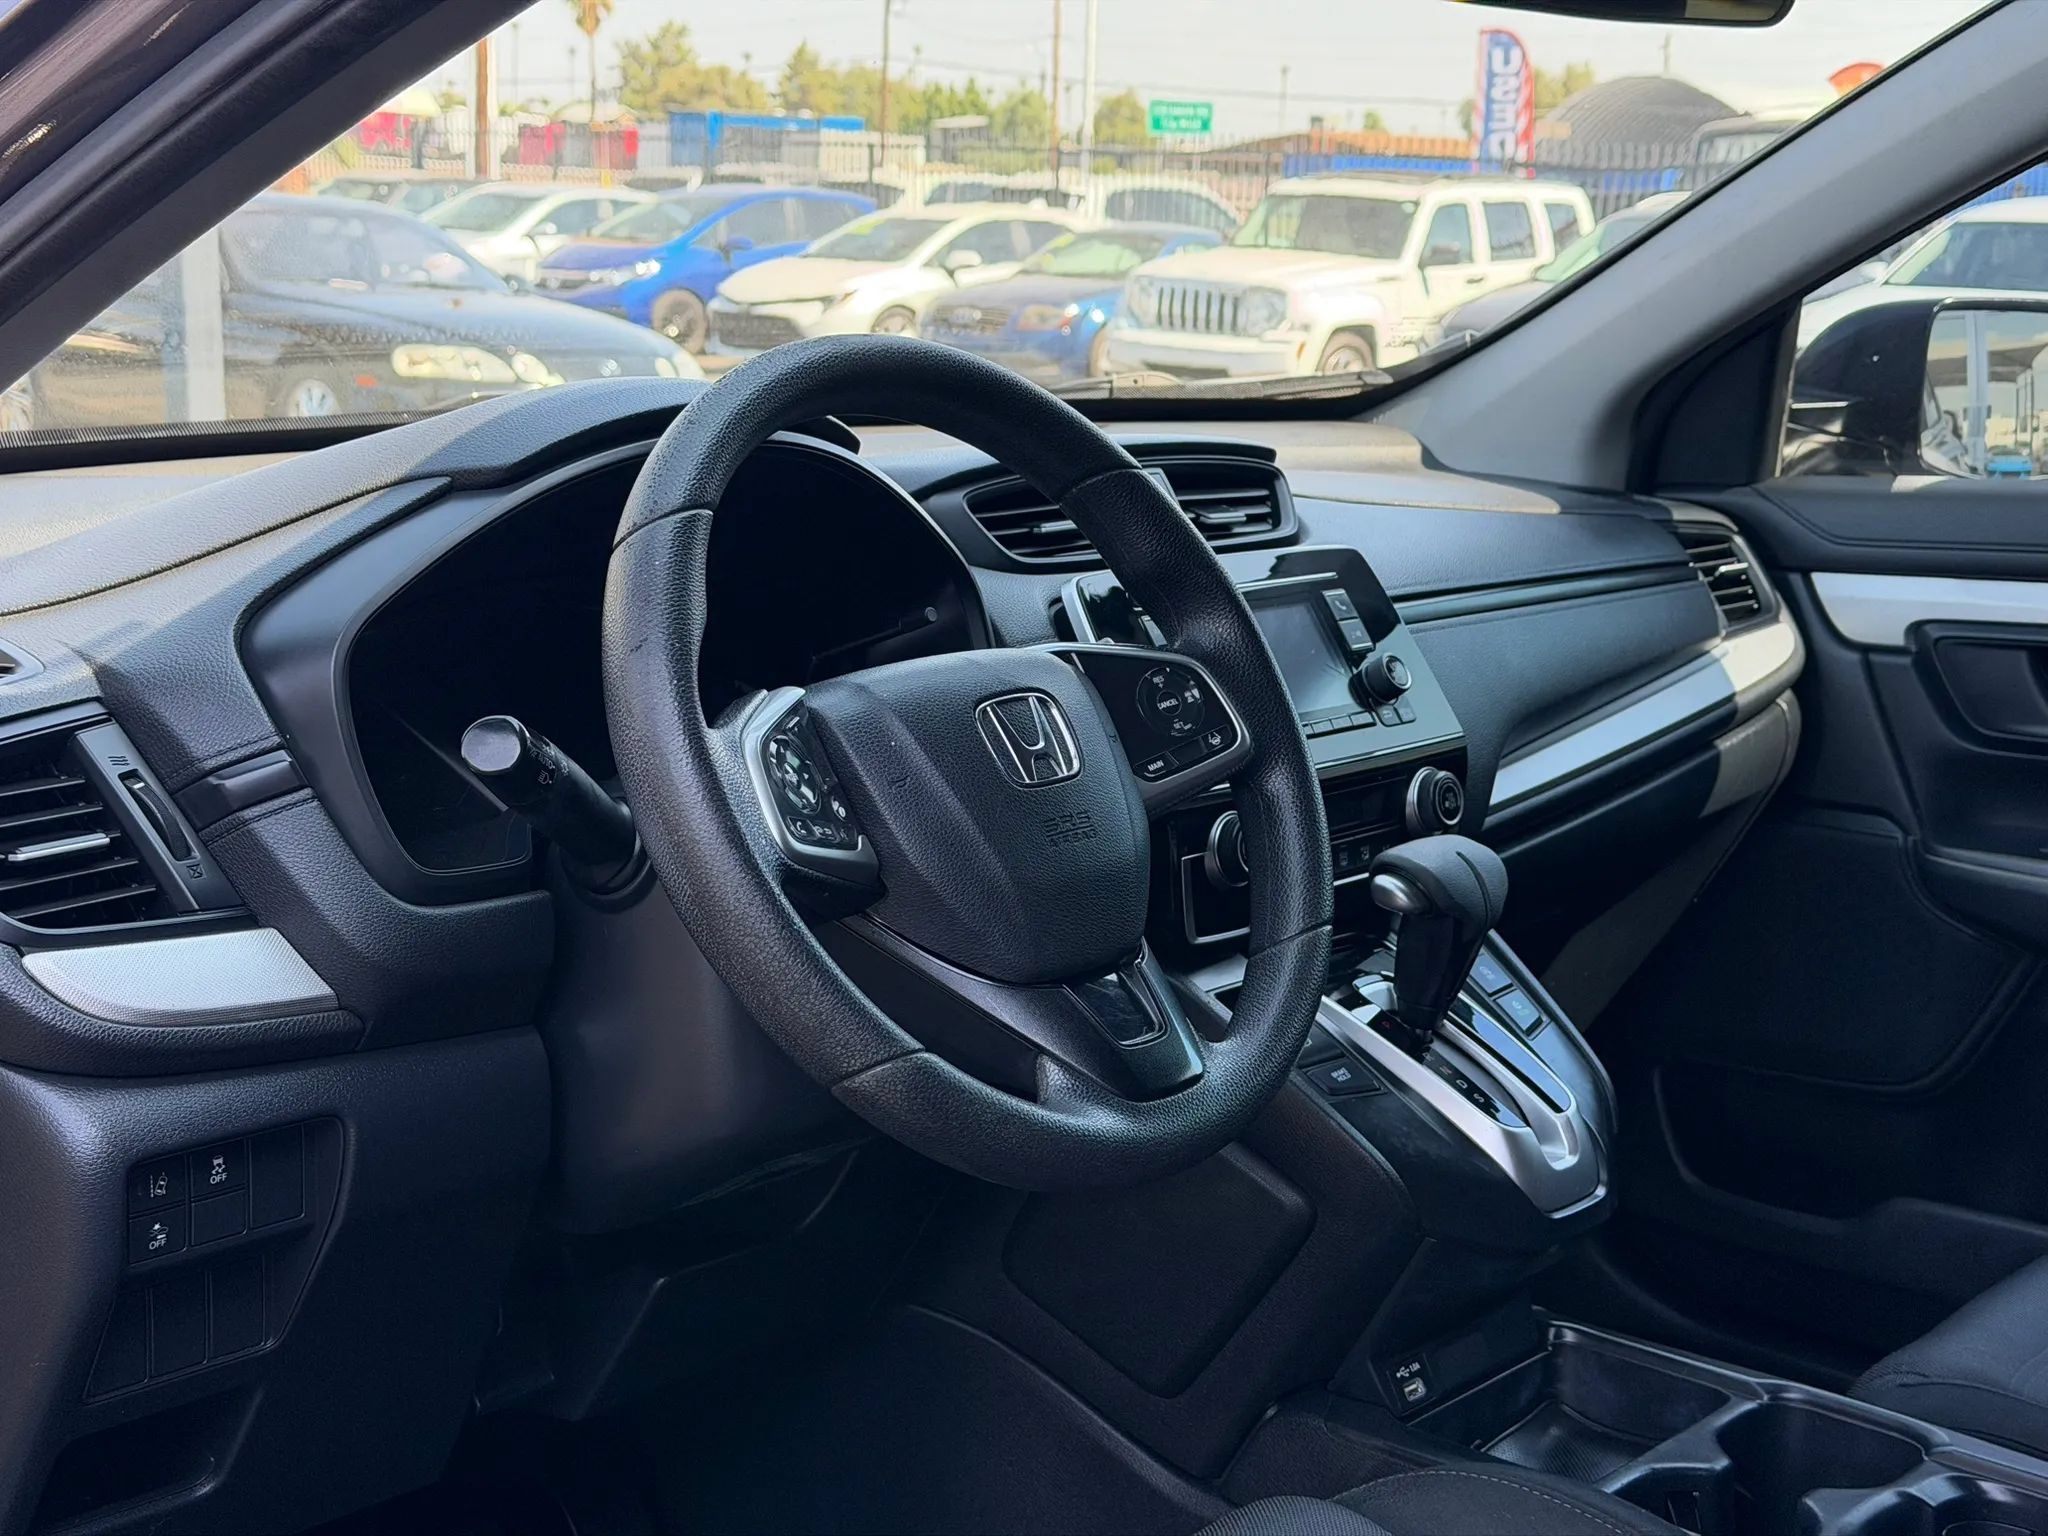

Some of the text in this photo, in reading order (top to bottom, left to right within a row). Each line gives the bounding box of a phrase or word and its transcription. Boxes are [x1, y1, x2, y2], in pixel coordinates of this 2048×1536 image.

[1157, 698, 1179, 710] CANCEL
[1147, 760, 1164, 772] MAIN
[1455, 1079, 1468, 1089] D
[1473, 1093, 1485, 1103] S
[209, 1172, 228, 1185] OFF
[148, 1237, 167, 1250] OFF
